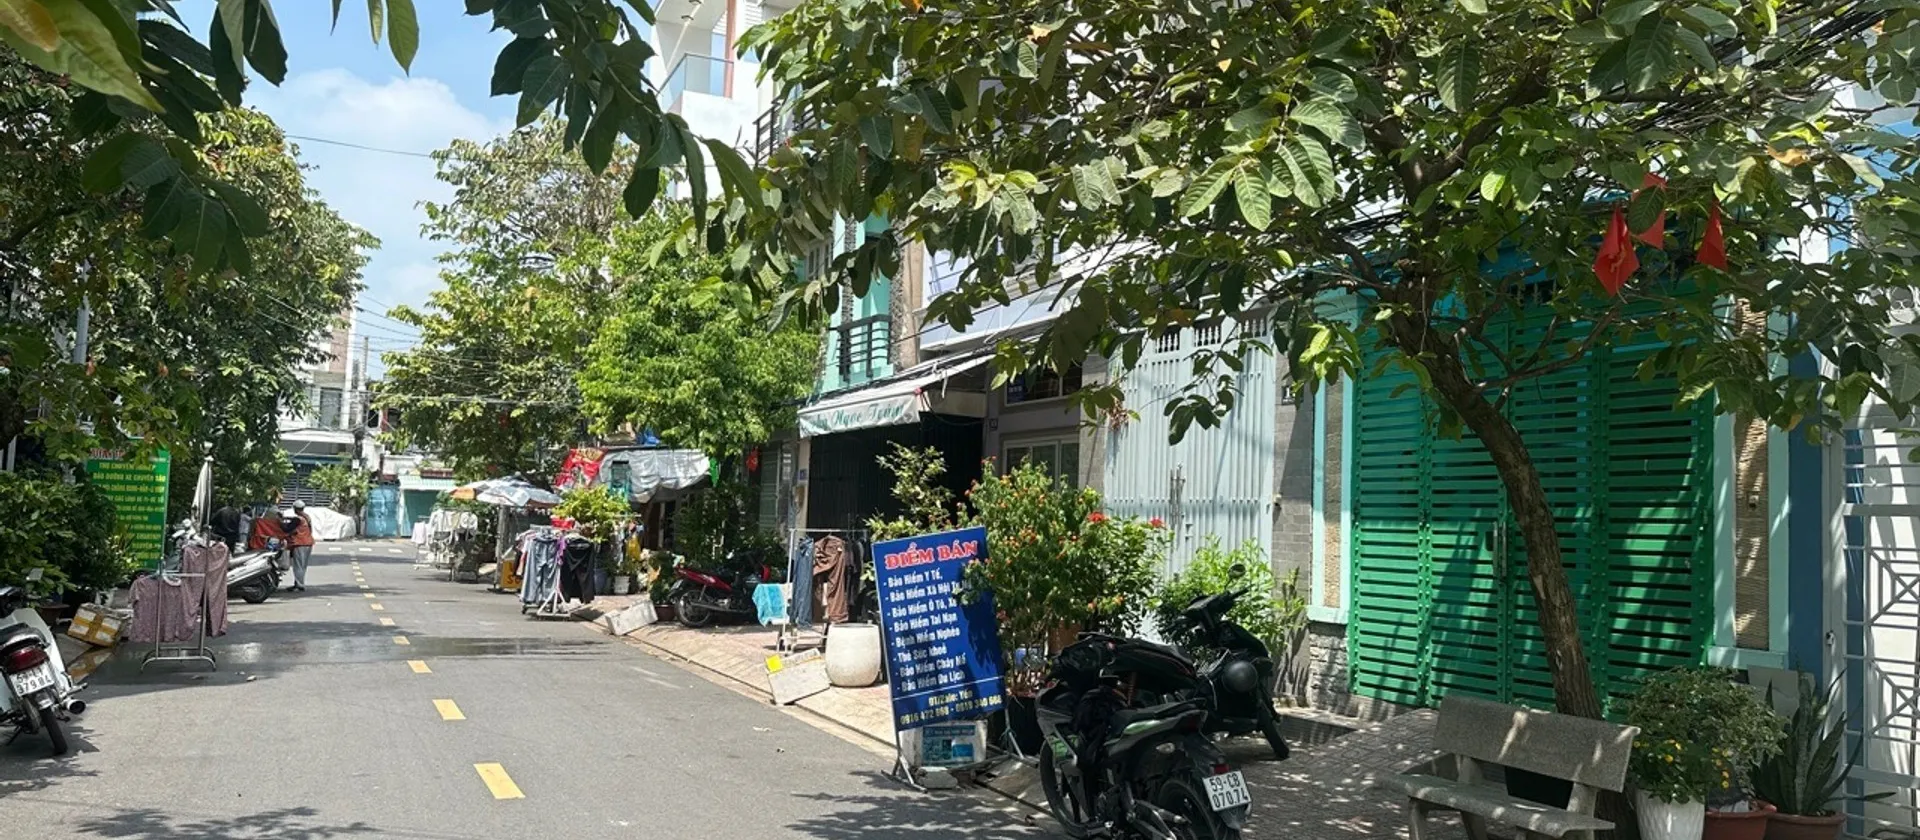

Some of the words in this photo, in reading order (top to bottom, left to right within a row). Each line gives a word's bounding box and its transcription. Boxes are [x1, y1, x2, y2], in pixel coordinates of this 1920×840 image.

[884, 542, 935, 570] ĐIỂM
[937, 539, 978, 561] BÁN
[888, 575, 903, 588] Bảo
[890, 589, 905, 602] Bảo
[892, 605, 907, 618] Bảo
[894, 619, 909, 632] Bảo
[1209, 772, 1240, 792] 59-CB
